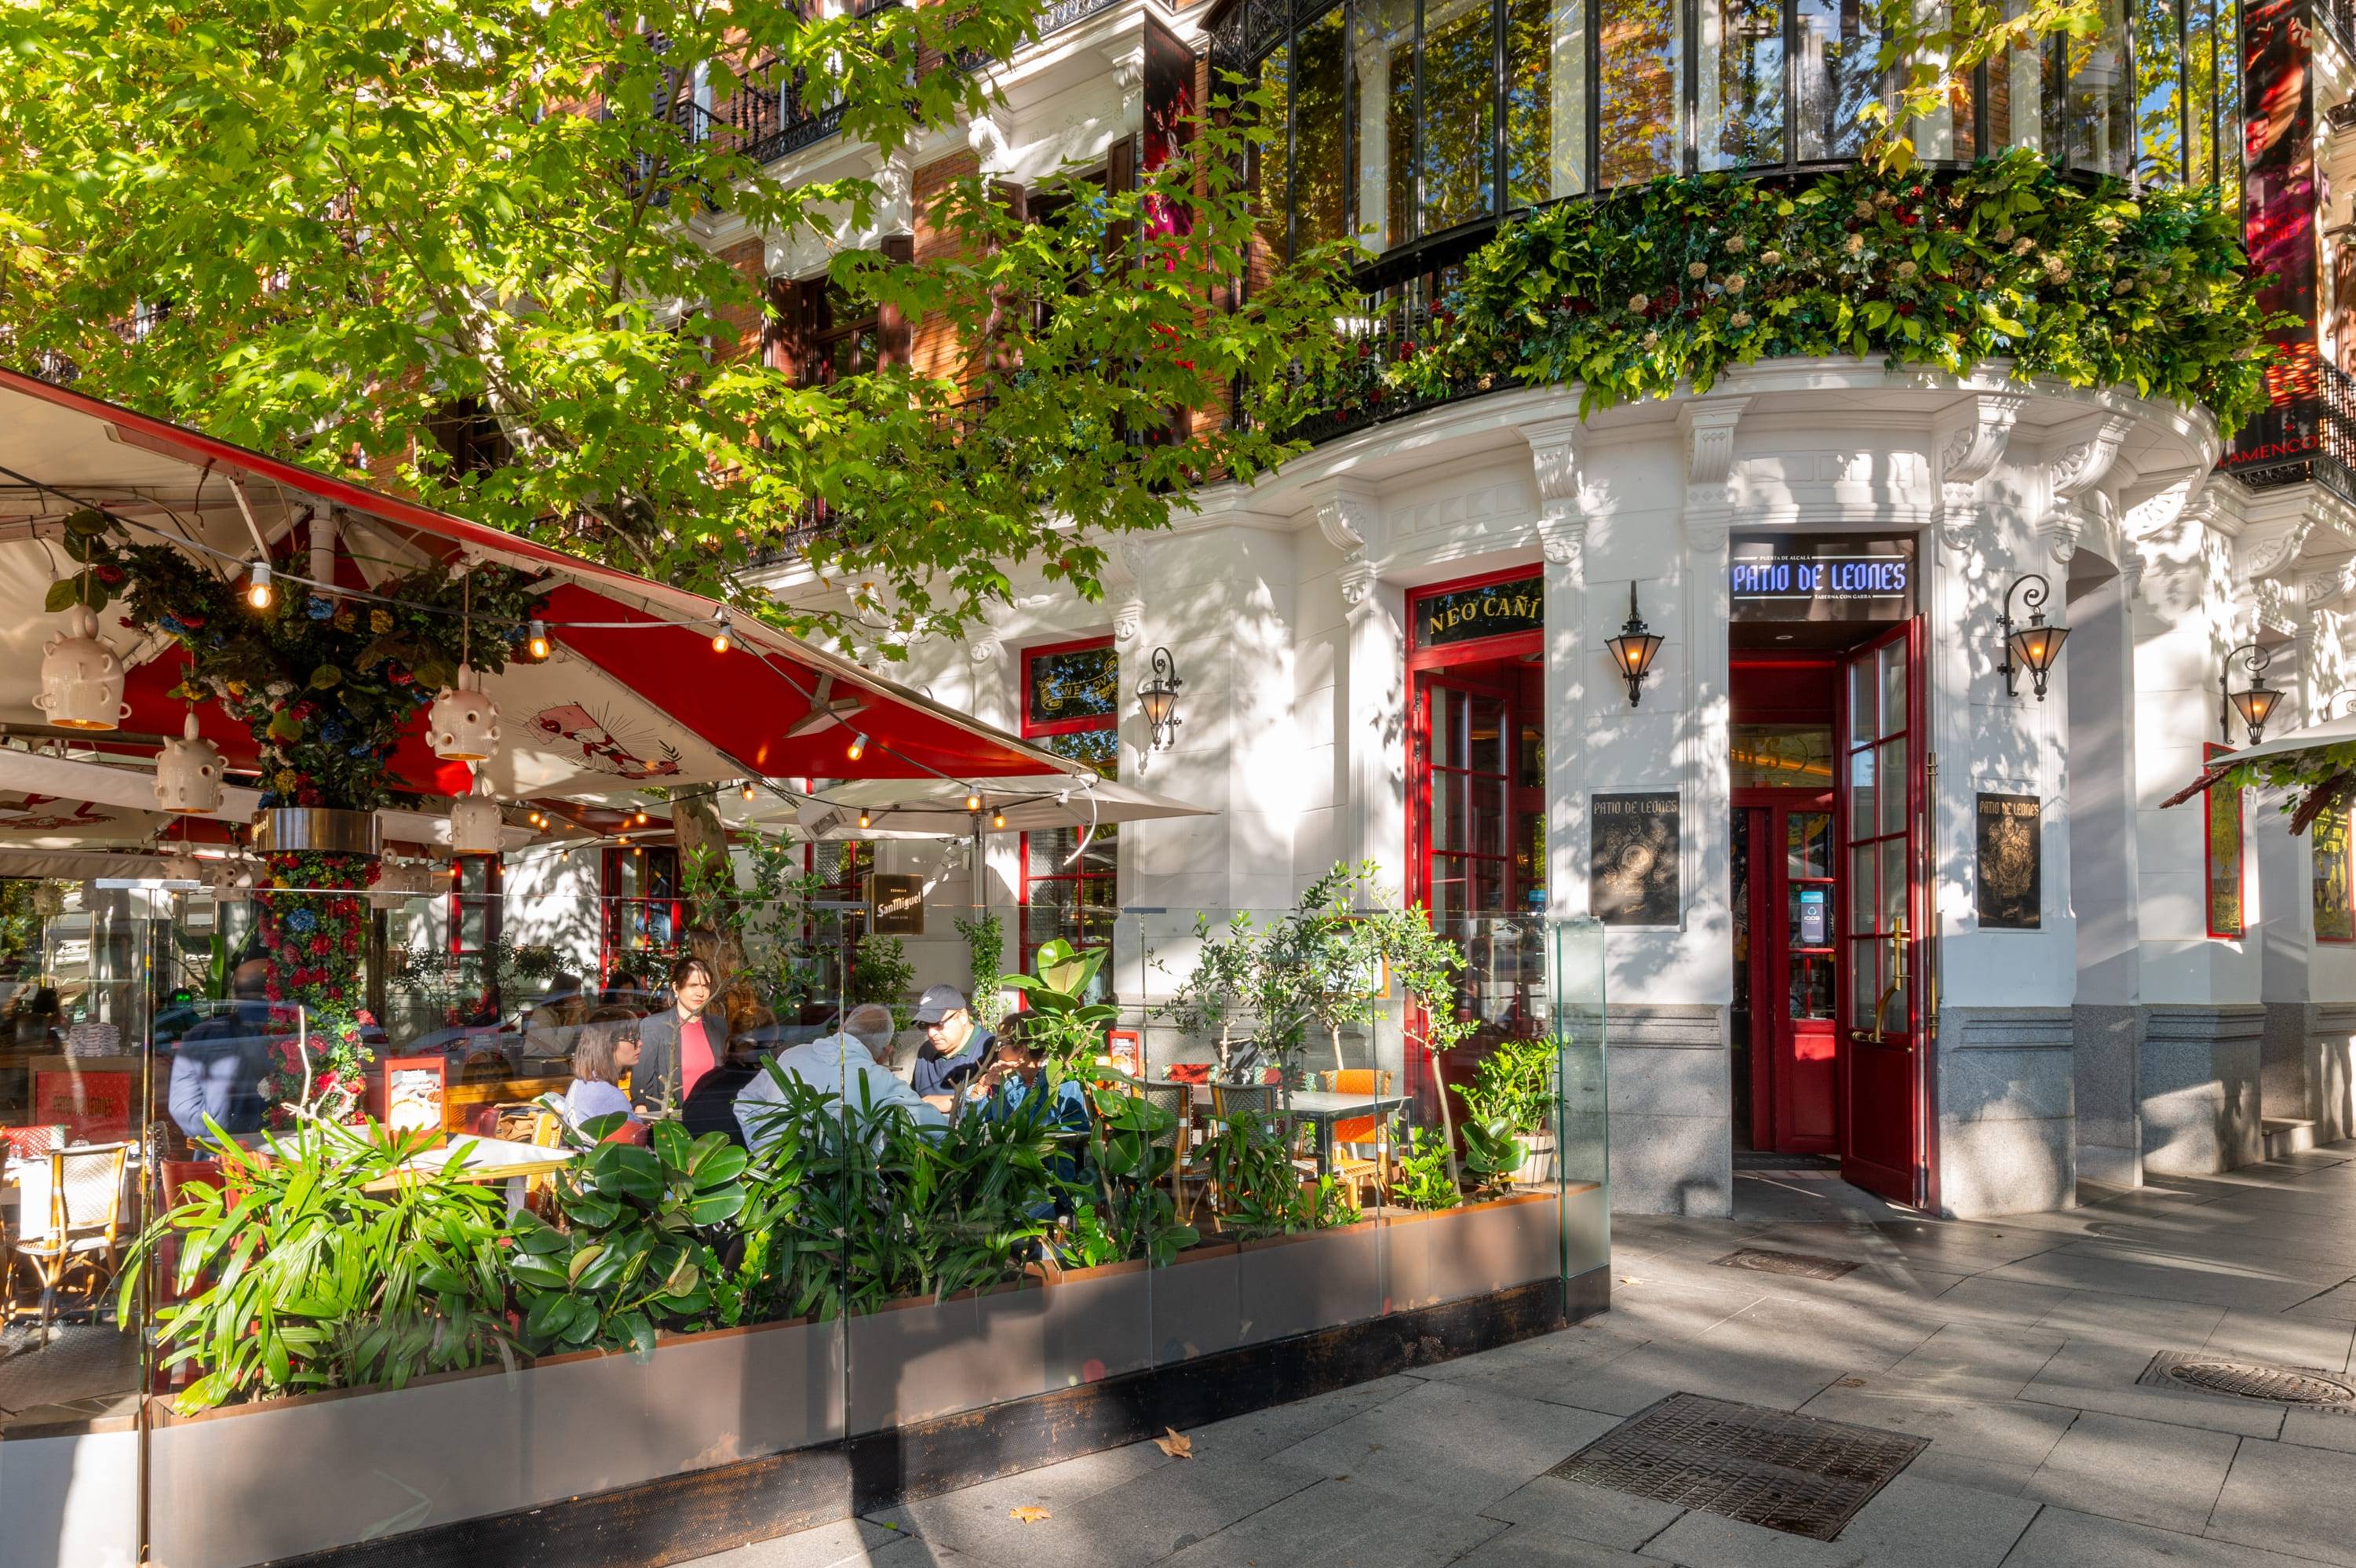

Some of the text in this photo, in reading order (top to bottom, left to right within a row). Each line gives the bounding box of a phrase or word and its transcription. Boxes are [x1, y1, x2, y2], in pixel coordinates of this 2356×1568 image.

[2216, 436, 2318, 468] LAMENCO
[1733, 563, 1906, 592] PATIO DE LEONES
[1430, 595, 1542, 635] NEO CAÑÍ
[1594, 800, 1677, 815] PATIO DE LEONES
[1979, 800, 2040, 817] PATIO DE LEONES
